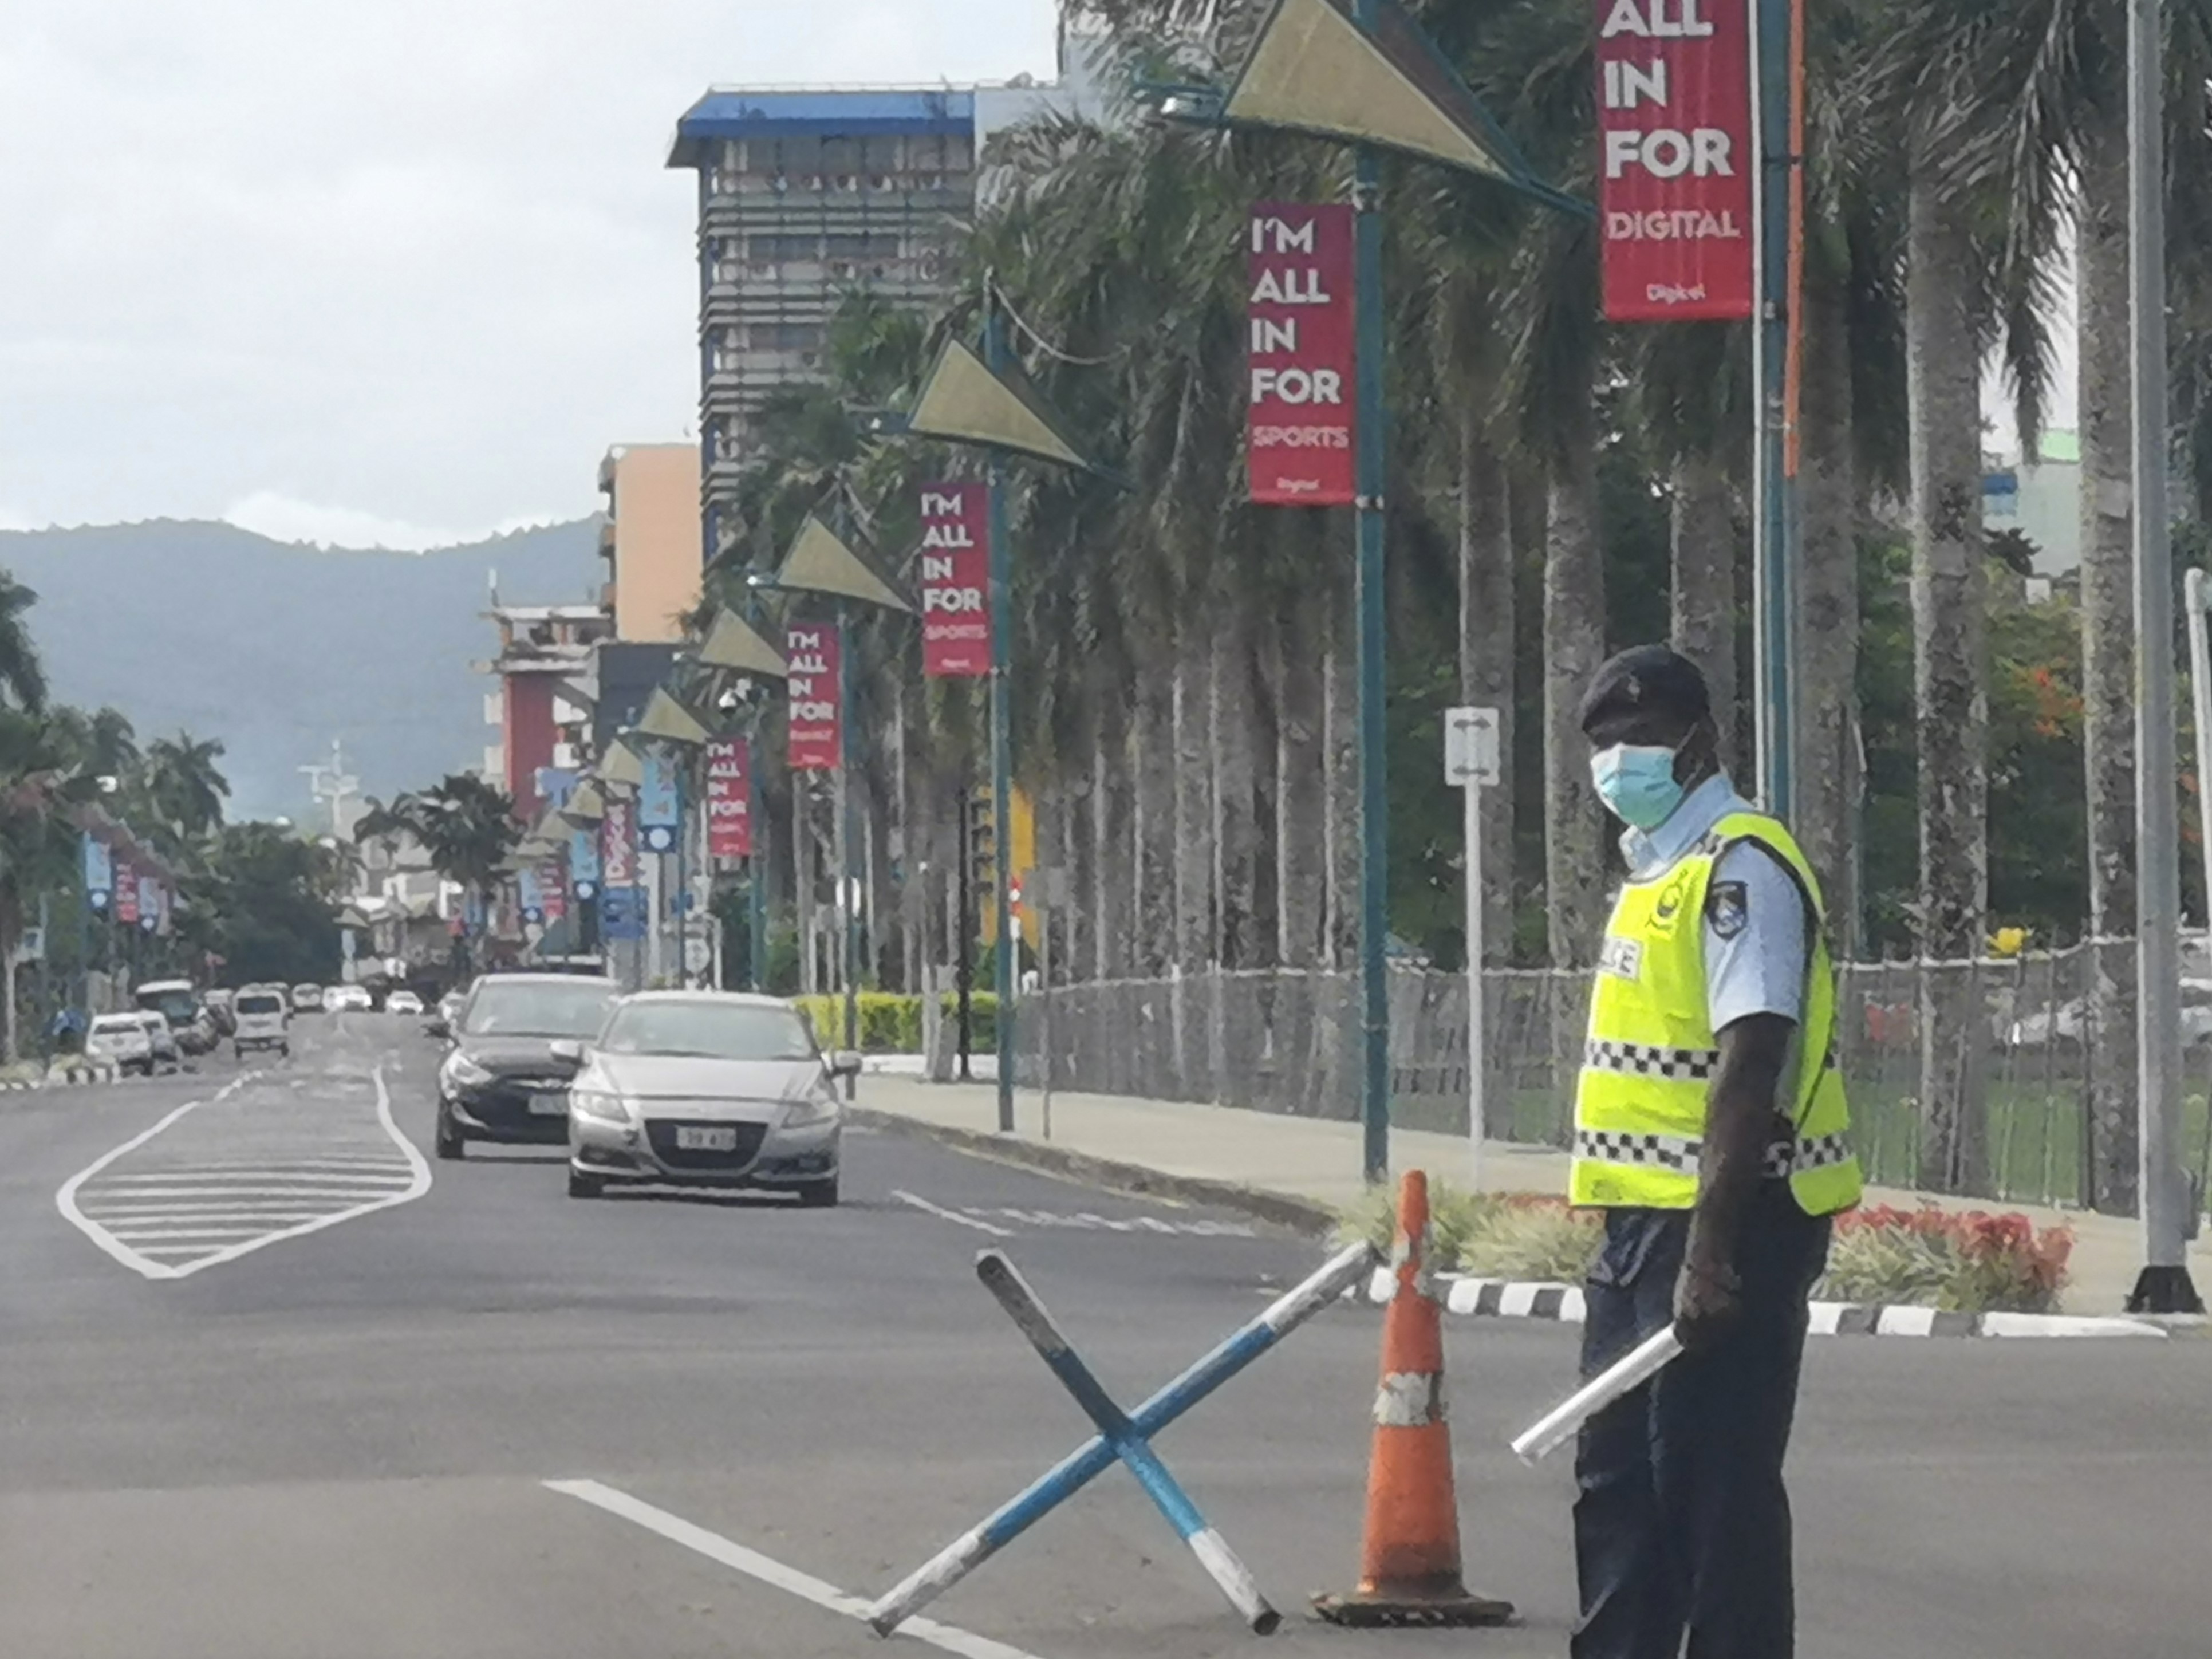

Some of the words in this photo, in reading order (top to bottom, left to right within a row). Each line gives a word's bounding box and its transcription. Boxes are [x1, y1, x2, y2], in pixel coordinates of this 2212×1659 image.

[1604, 58, 1667, 108] IN
[1606, 128, 1736, 178] FOR
[1252, 218, 1314, 253] I'M
[1608, 210, 1741, 239] DIGITAL
[1249, 269, 1331, 303] ALL
[1252, 318, 1295, 353] IN
[1251, 368, 1340, 403] FOR
[1253, 425, 1349, 448] SPORTS
[921, 492, 962, 515] I'M
[922, 524, 973, 547] ALL
[924, 556, 952, 580] IN
[924, 588, 982, 612] FOR
[789, 654, 829, 673] ALL
